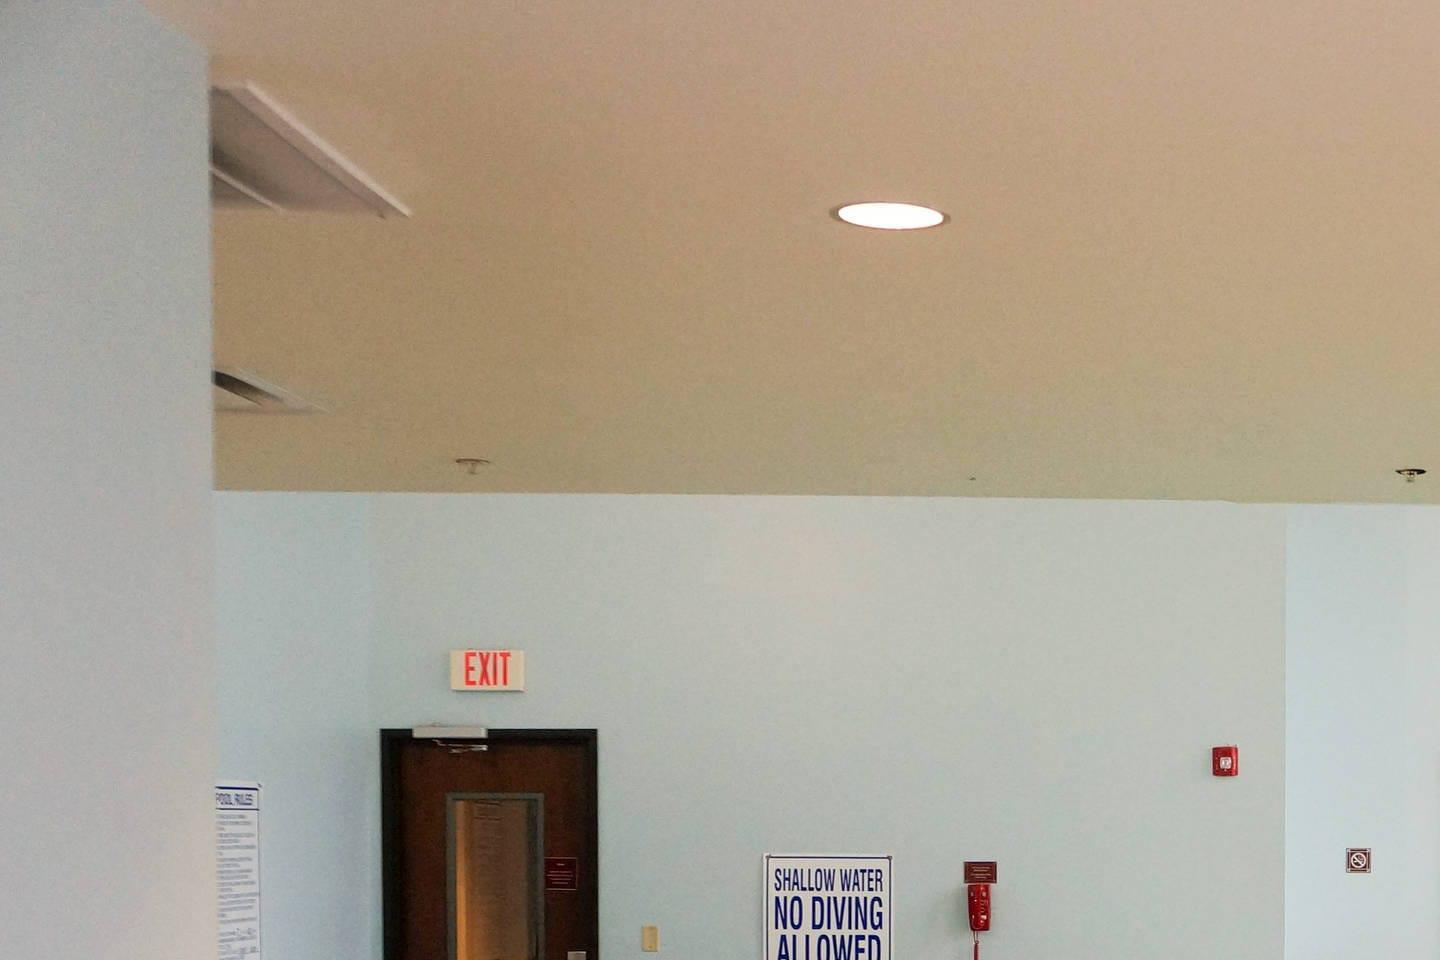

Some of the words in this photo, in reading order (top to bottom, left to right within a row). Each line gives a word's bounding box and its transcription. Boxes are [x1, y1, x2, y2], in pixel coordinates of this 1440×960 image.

[464, 651, 511, 687] EXIT
[774, 868, 836, 892] SHALLOW
[839, 868, 884, 892] WATER
[774, 896, 803, 931] NO
[811, 896, 884, 931] DIVING
